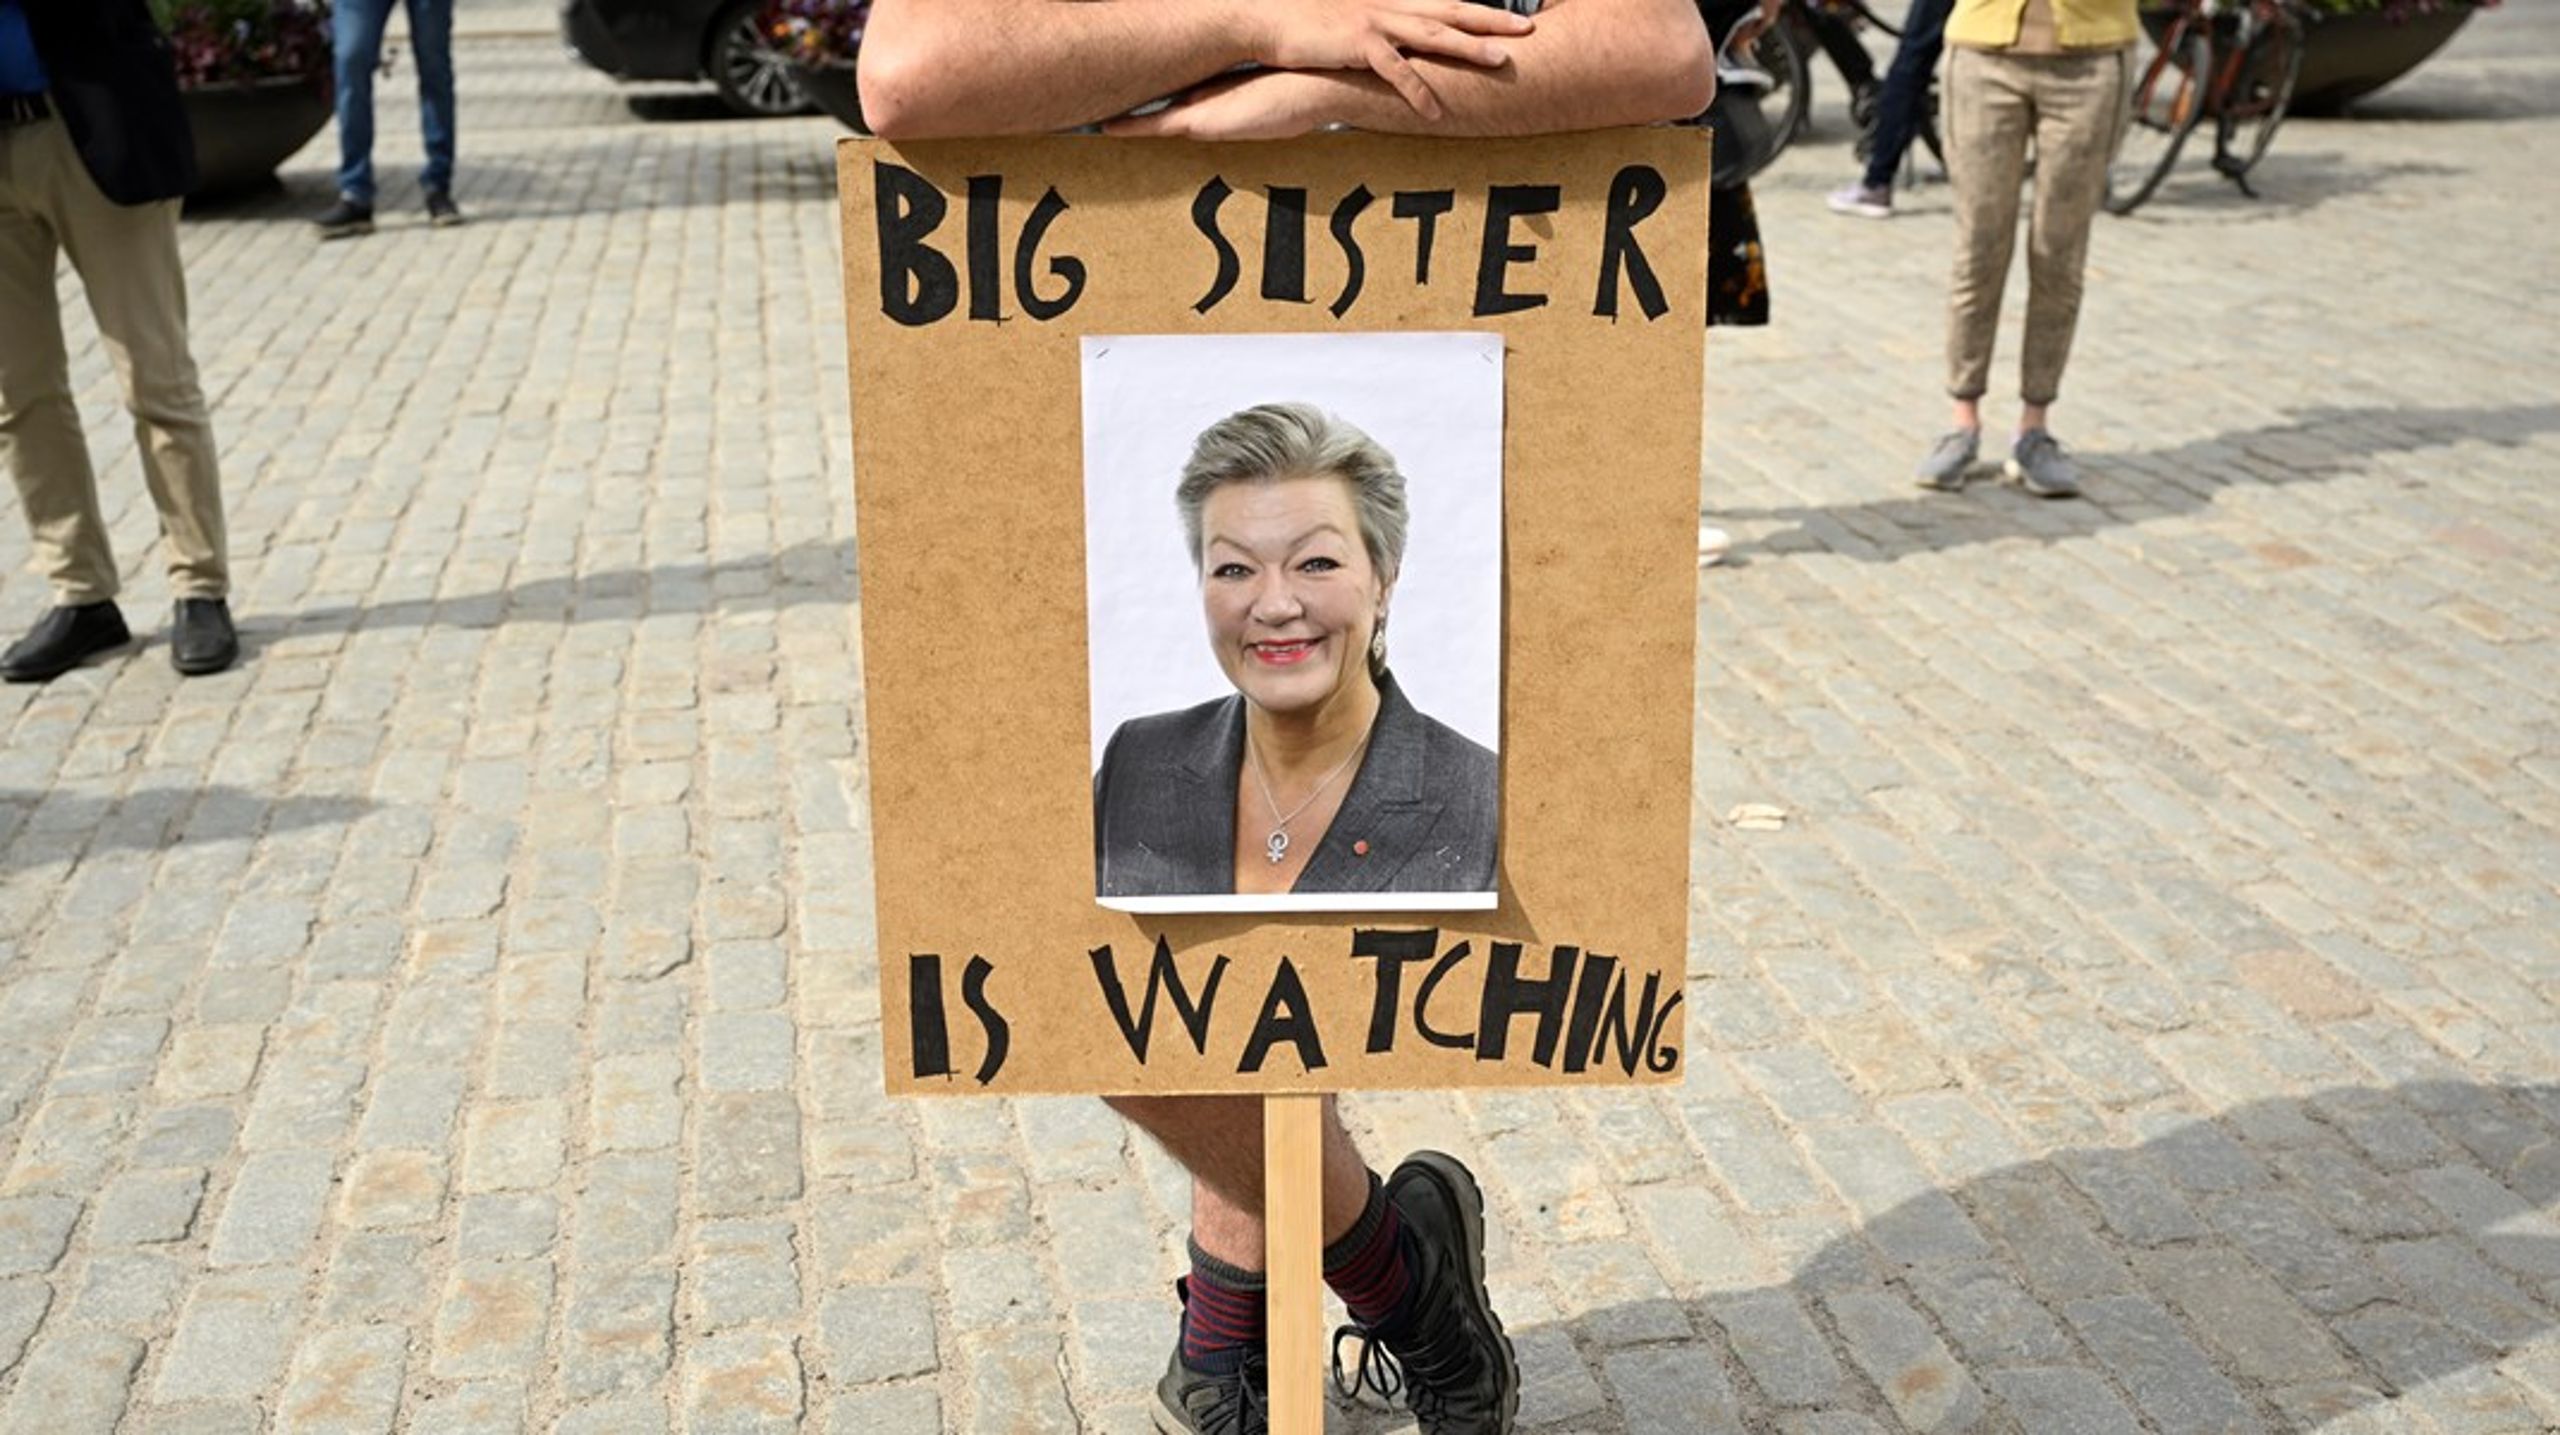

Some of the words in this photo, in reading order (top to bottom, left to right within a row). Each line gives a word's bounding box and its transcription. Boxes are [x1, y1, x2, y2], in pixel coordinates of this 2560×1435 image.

[873, 159, 1087, 327] BIG
[1190, 164, 1670, 324] SISTER
[909, 954, 1009, 1086] IS
[1088, 927, 1683, 1078] WATCHING
